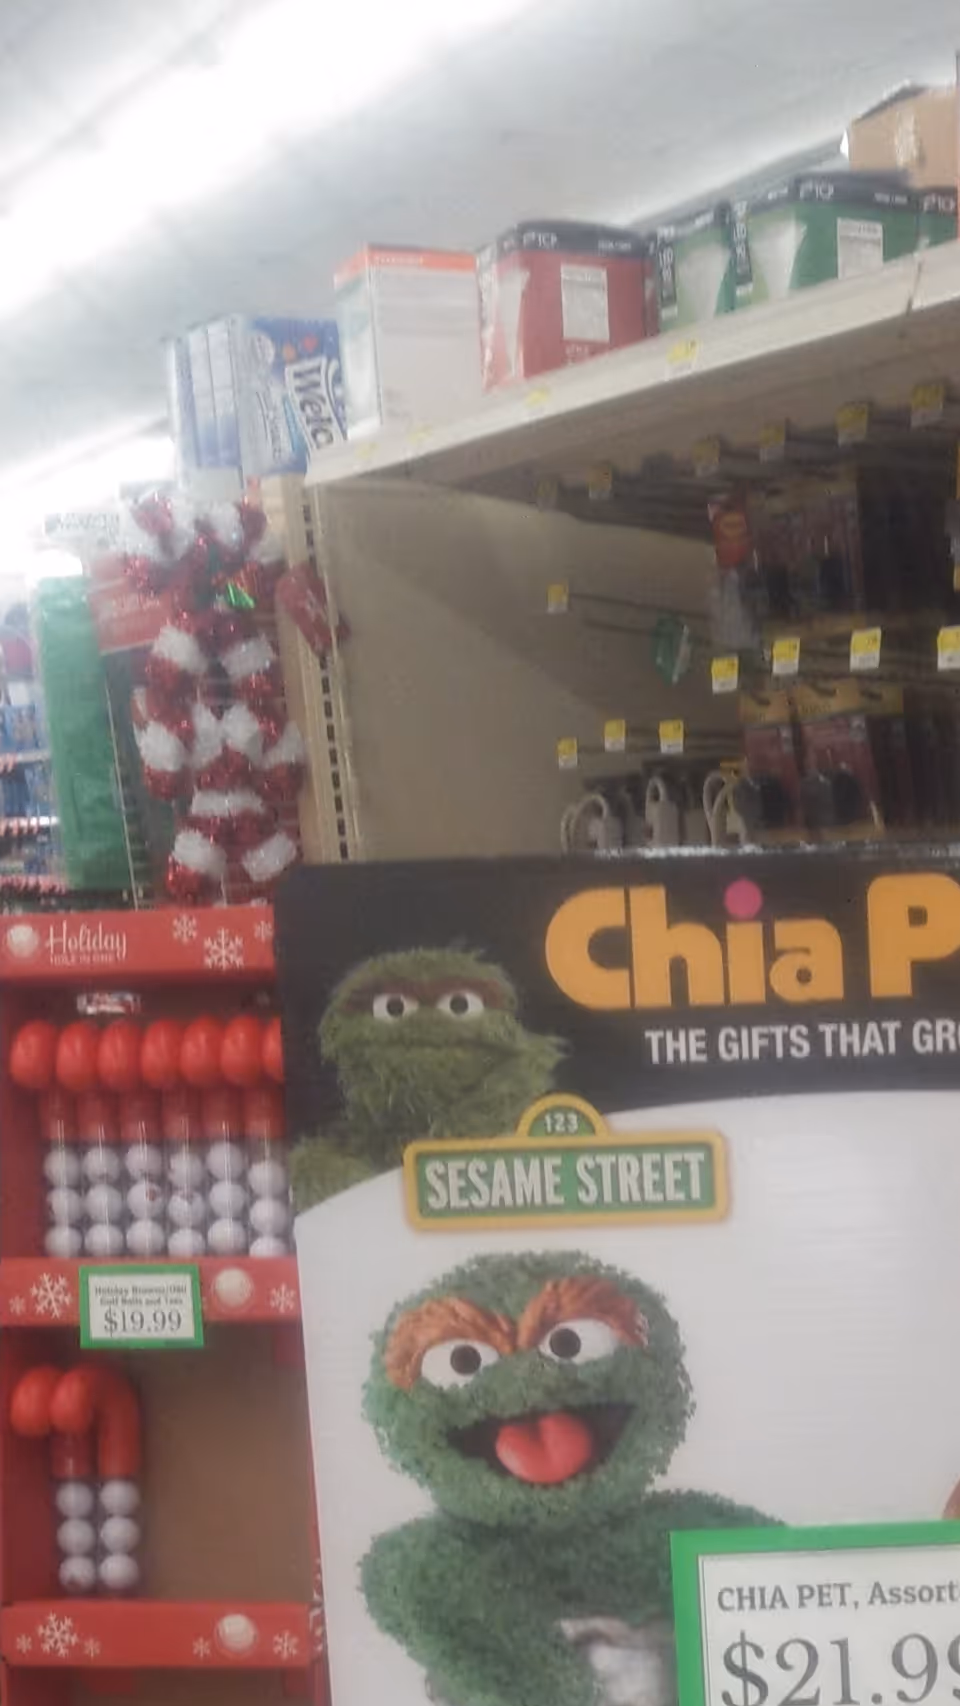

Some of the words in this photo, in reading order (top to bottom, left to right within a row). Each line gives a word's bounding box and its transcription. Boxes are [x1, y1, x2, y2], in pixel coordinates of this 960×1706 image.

[45, 920, 127, 961] Holiday
[545, 877, 843, 1010] Chia
[645, 1029, 708, 1065] THE
[718, 1024, 810, 1063] GIFTS
[818, 1021, 902, 1058] THAT
[544, 1111, 579, 1134] 123
[424, 1154, 565, 1210] SESAME
[576, 1151, 705, 1206] STREET
[103, 1305, 183, 1338] $19.99
[717, 1585, 790, 1613] CHIA
[797, 1582, 860, 1611] PET,
